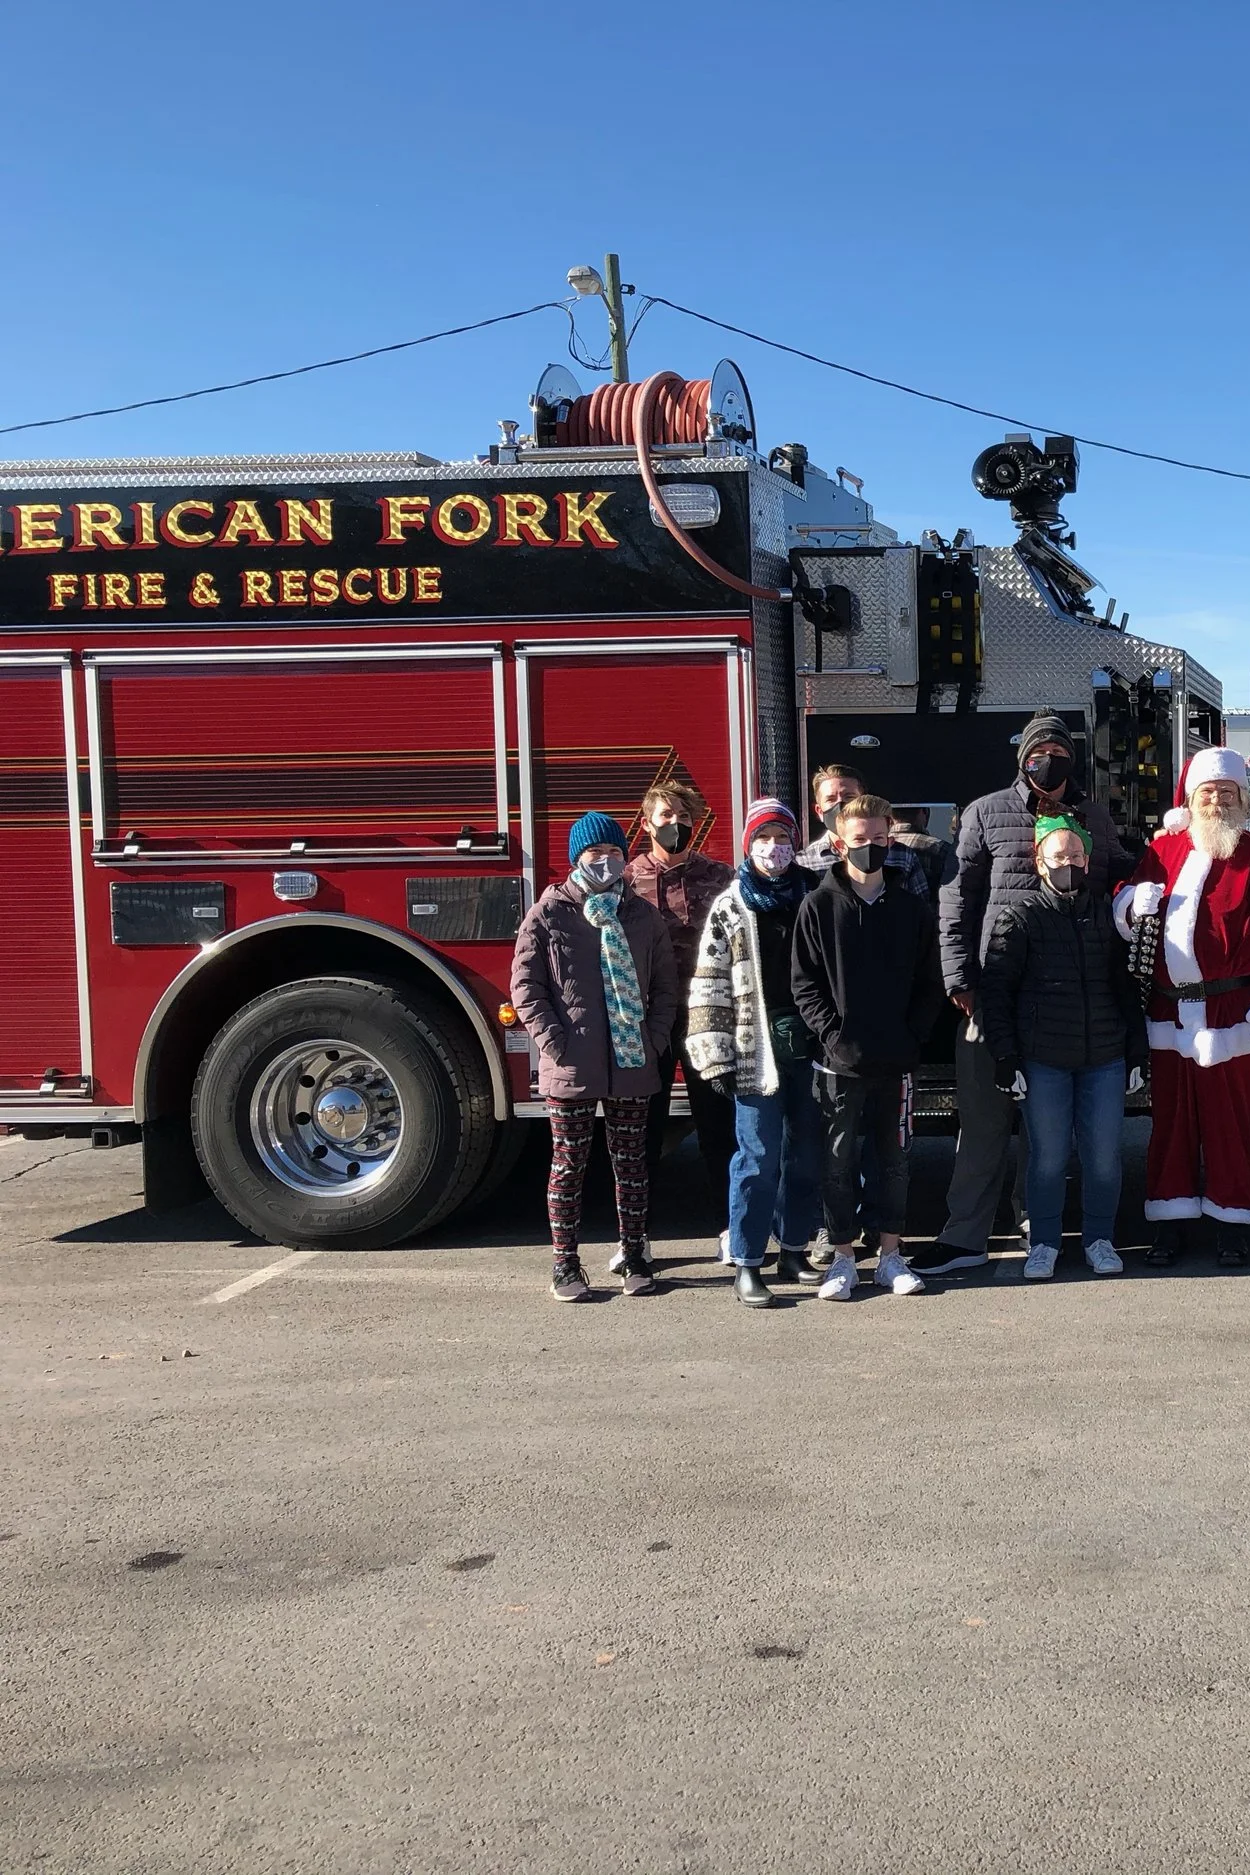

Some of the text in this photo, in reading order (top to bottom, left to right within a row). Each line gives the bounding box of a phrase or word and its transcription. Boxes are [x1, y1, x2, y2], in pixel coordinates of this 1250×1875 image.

[0, 491, 621, 556] ERICAN FORK
[47, 566, 444, 612] FIRE & RESCUE
